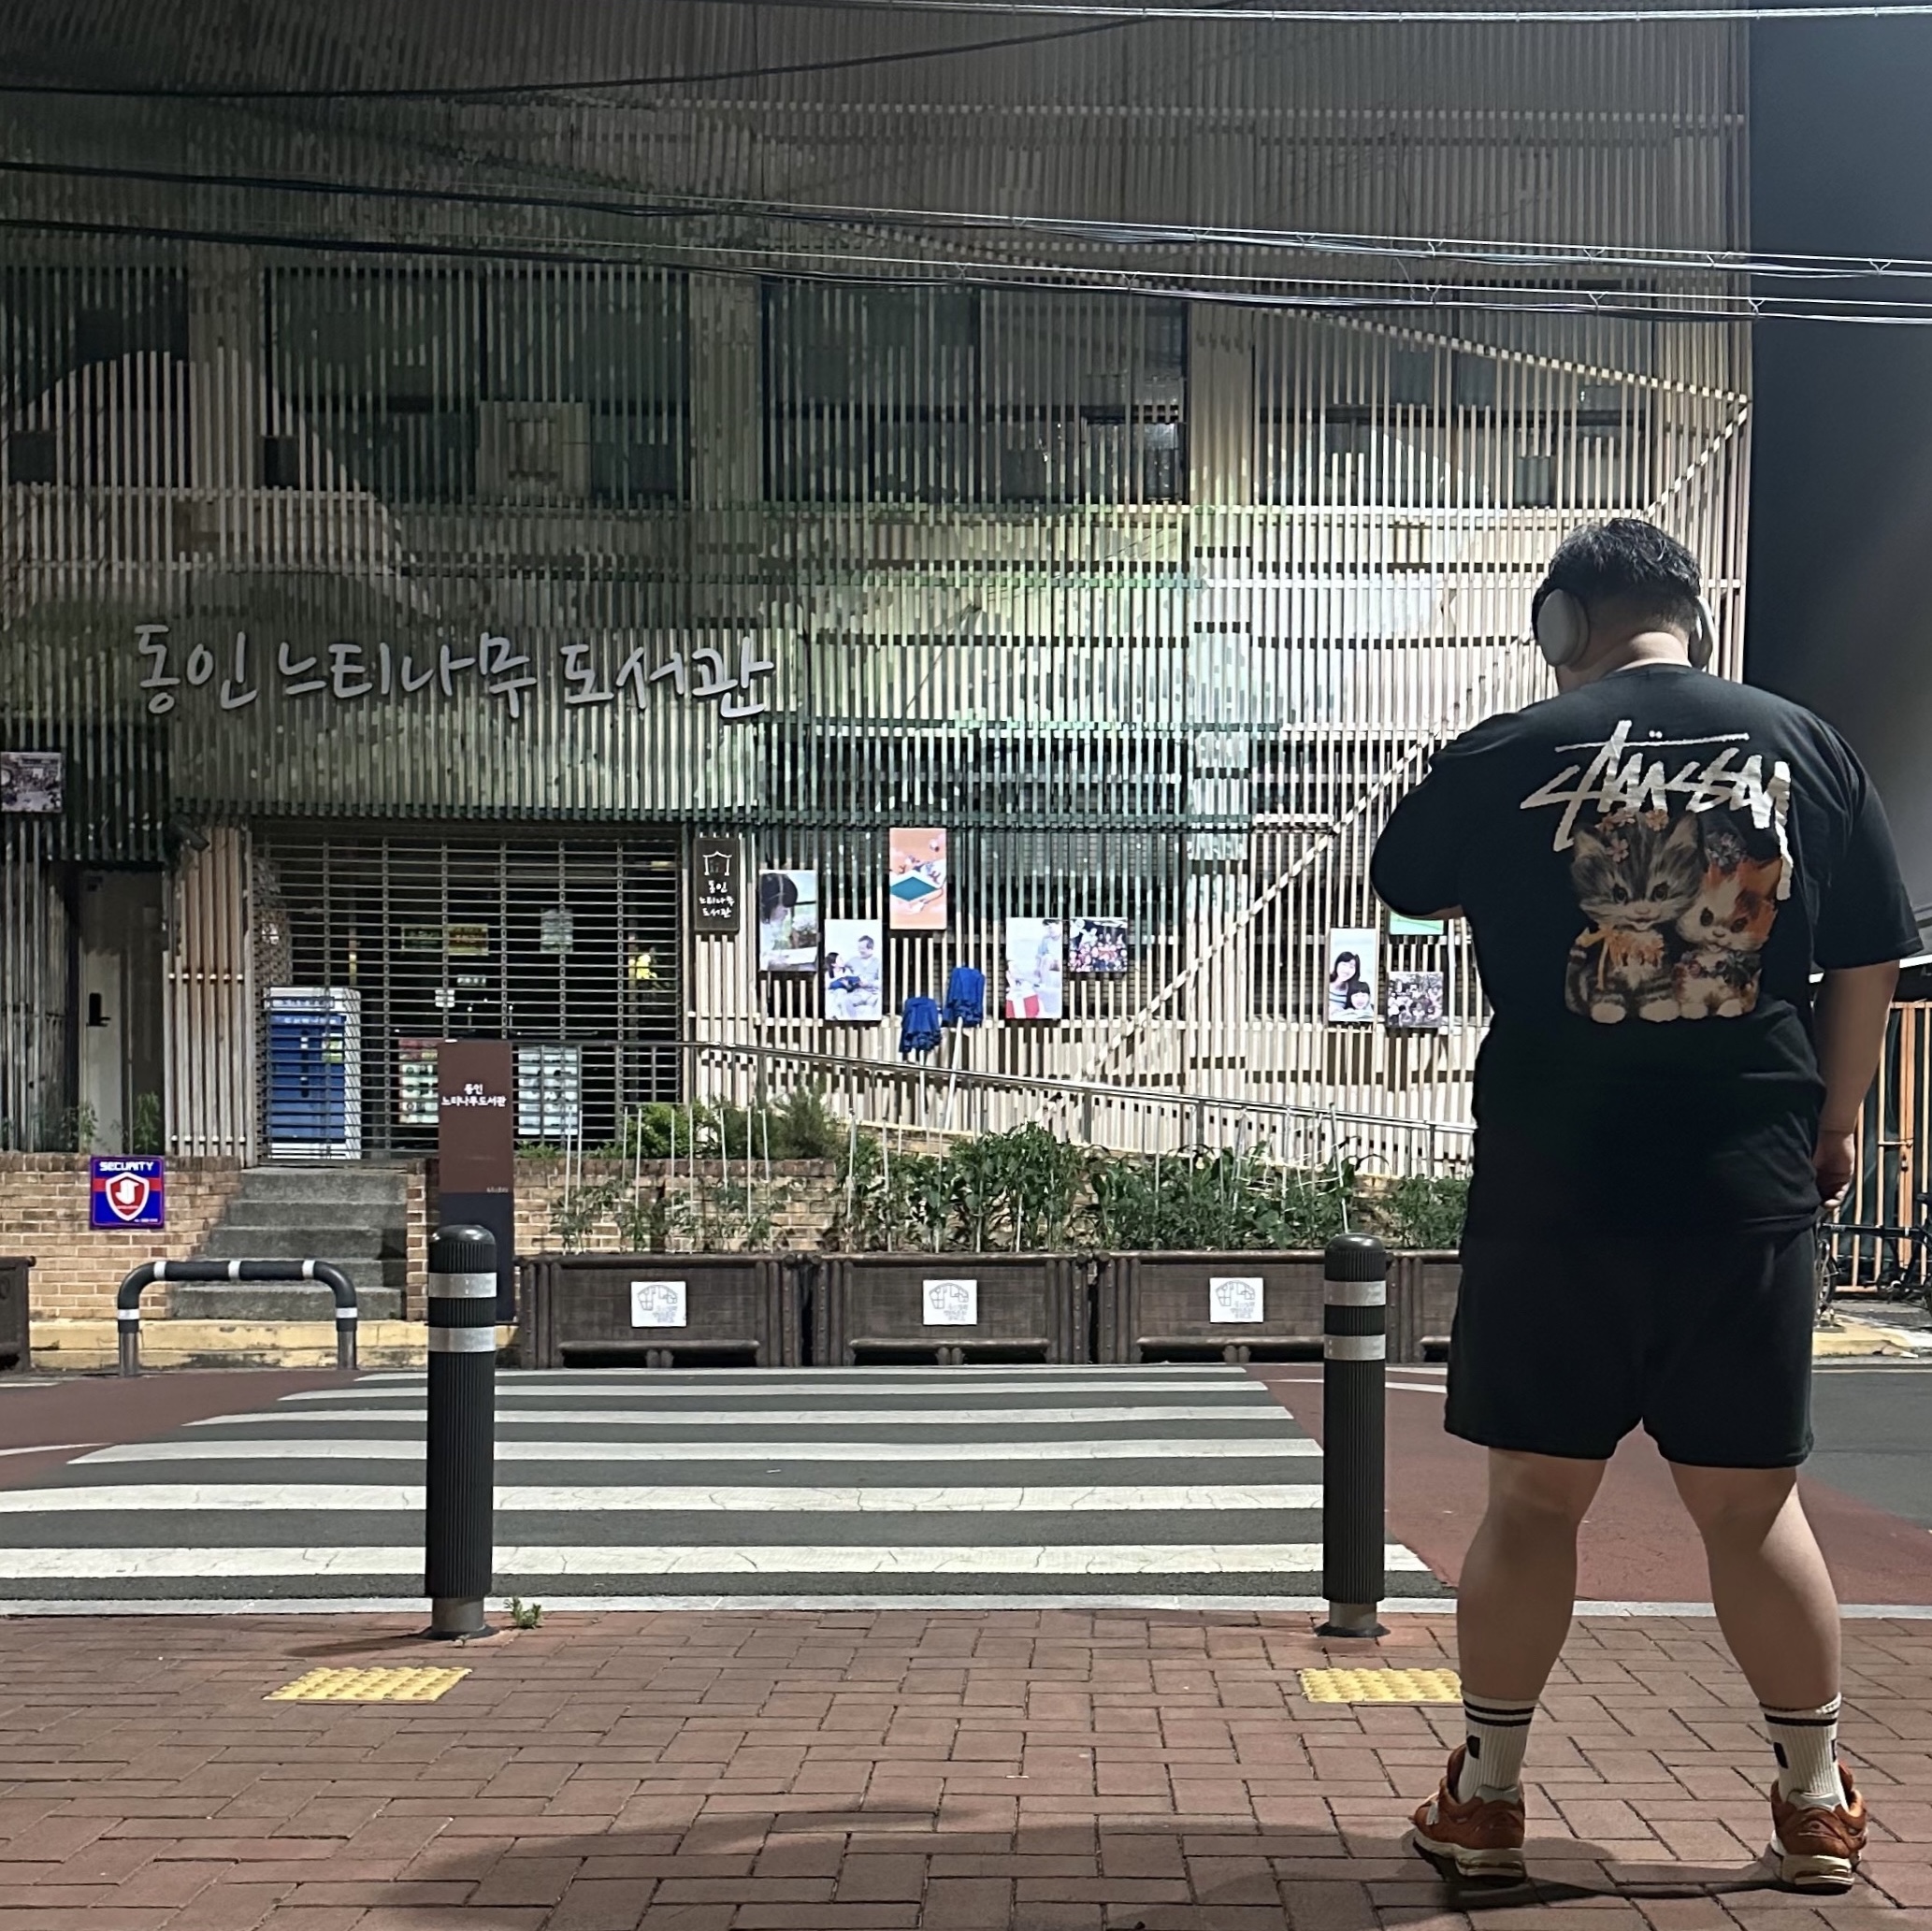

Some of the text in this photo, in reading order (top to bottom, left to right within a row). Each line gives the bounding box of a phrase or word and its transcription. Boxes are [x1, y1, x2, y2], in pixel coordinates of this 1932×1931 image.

[134, 624, 774, 718] 동인 느티나무 도서관
[99, 1161, 154, 1171] SECURITY
